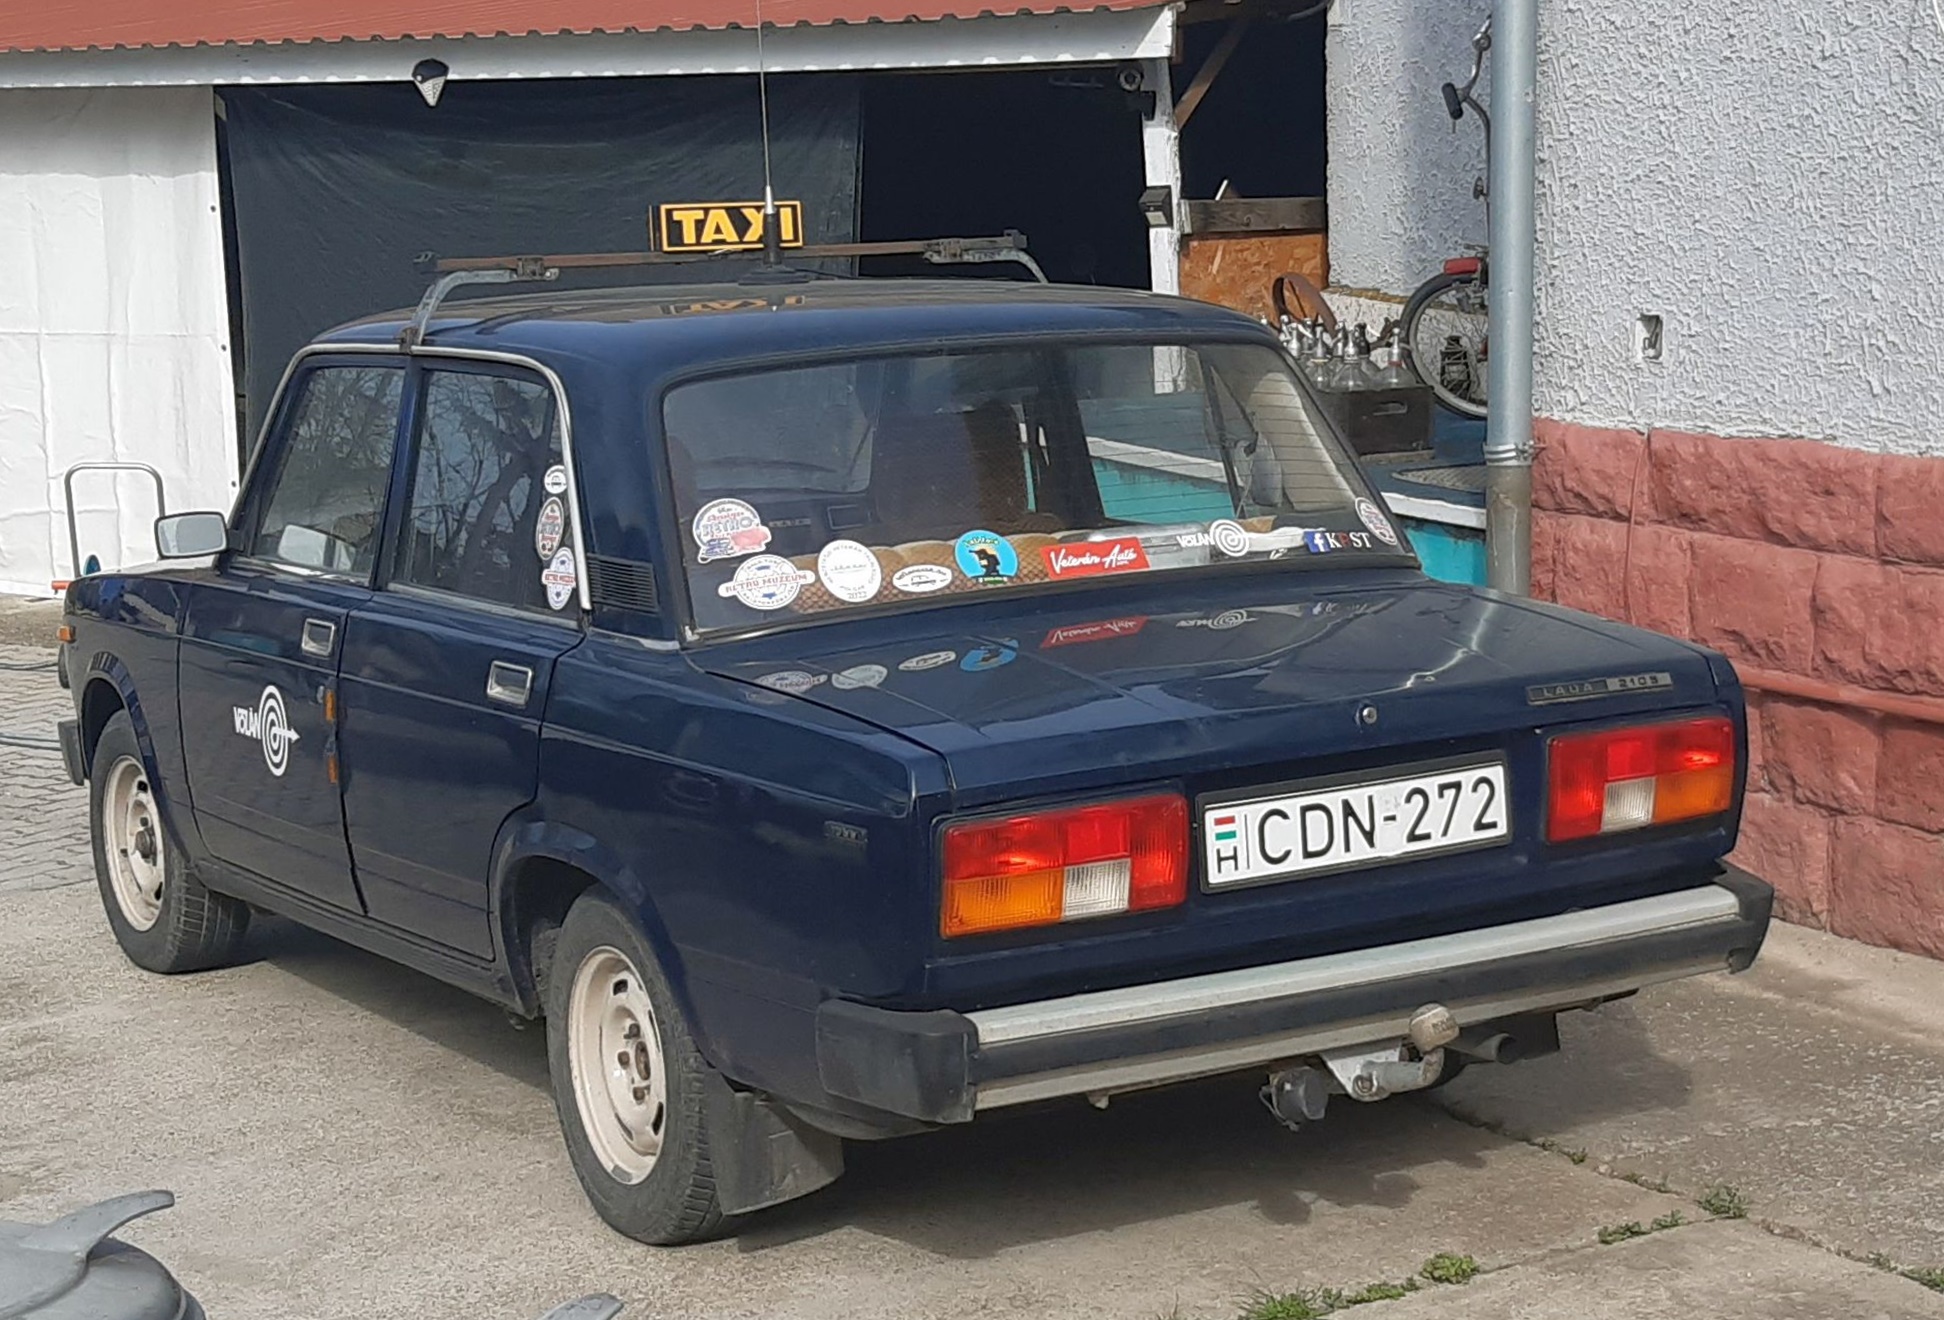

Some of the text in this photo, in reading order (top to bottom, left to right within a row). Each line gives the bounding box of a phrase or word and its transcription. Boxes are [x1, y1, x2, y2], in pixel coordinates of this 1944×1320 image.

[672, 207, 794, 245] TAXI
[1543, 682, 1594, 697] LADA
[1216, 776, 1498, 874] H CDN-272
